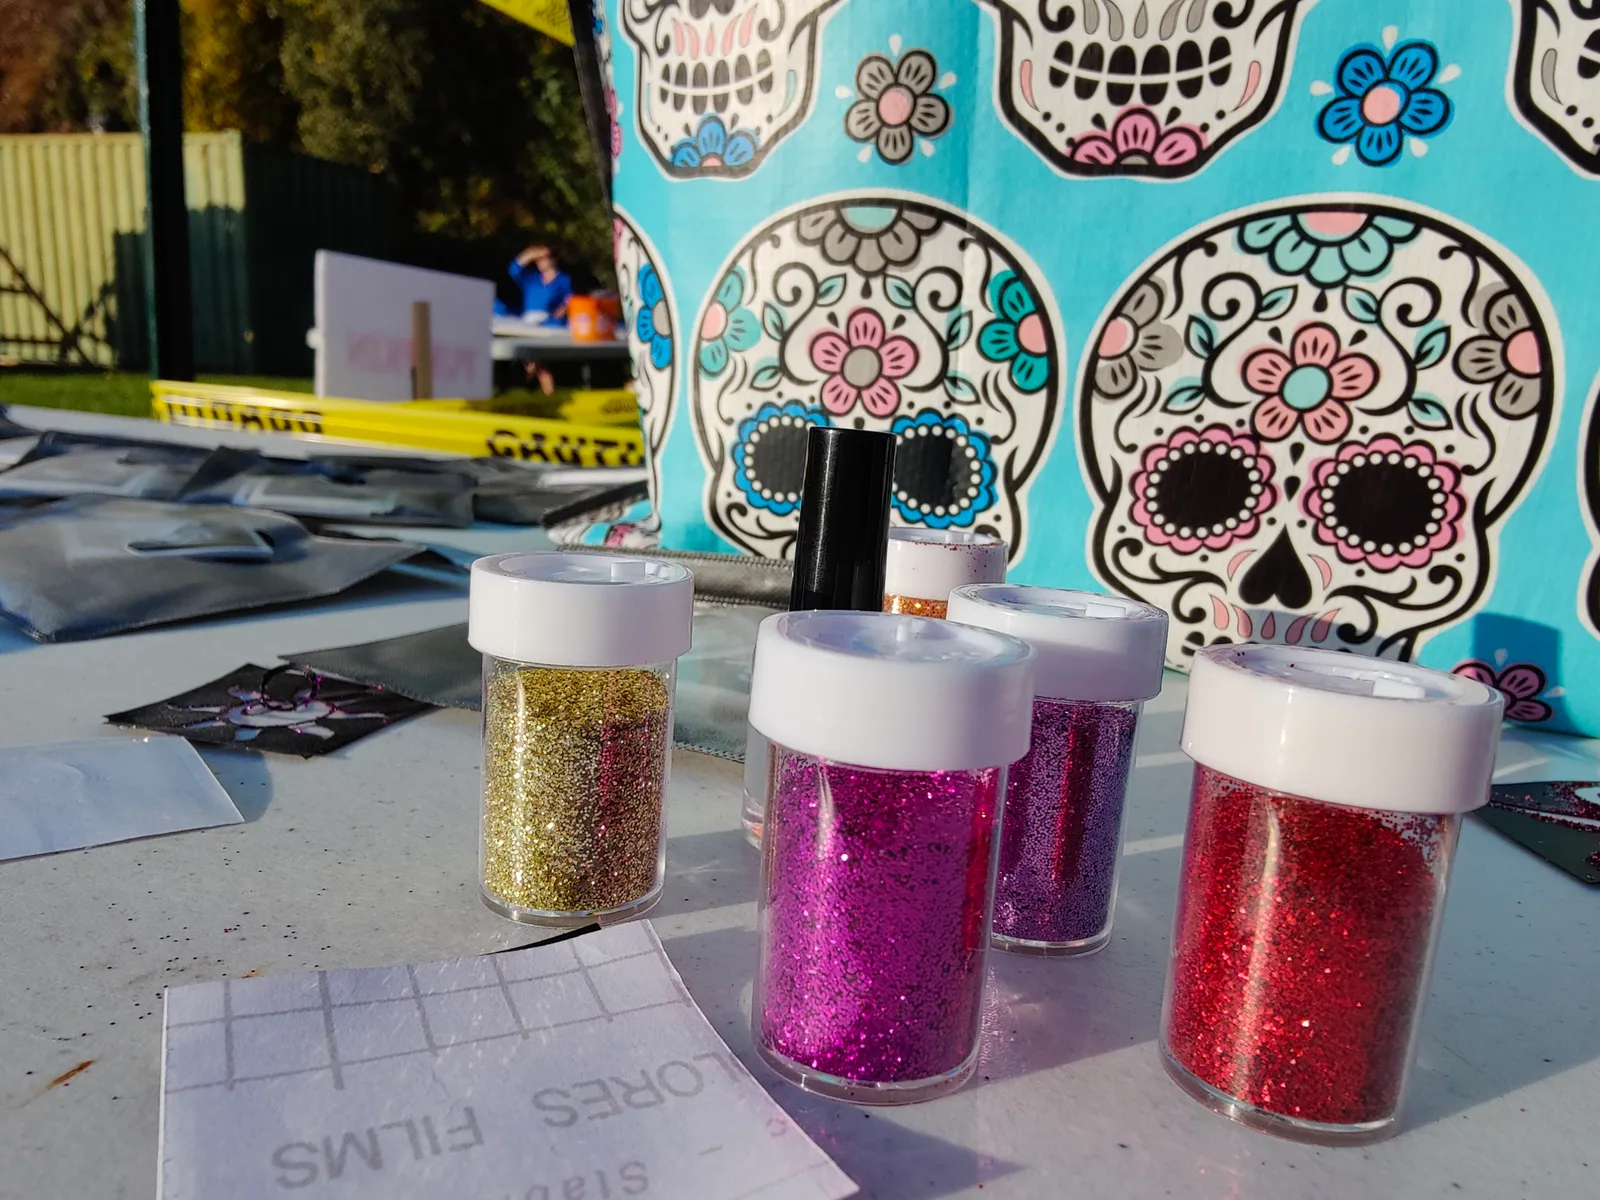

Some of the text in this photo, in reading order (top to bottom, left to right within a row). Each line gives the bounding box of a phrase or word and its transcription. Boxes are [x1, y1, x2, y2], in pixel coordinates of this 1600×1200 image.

[486, 429, 644, 466] CAUTI
[271, 1051, 750, 1189] LORES FILMS
